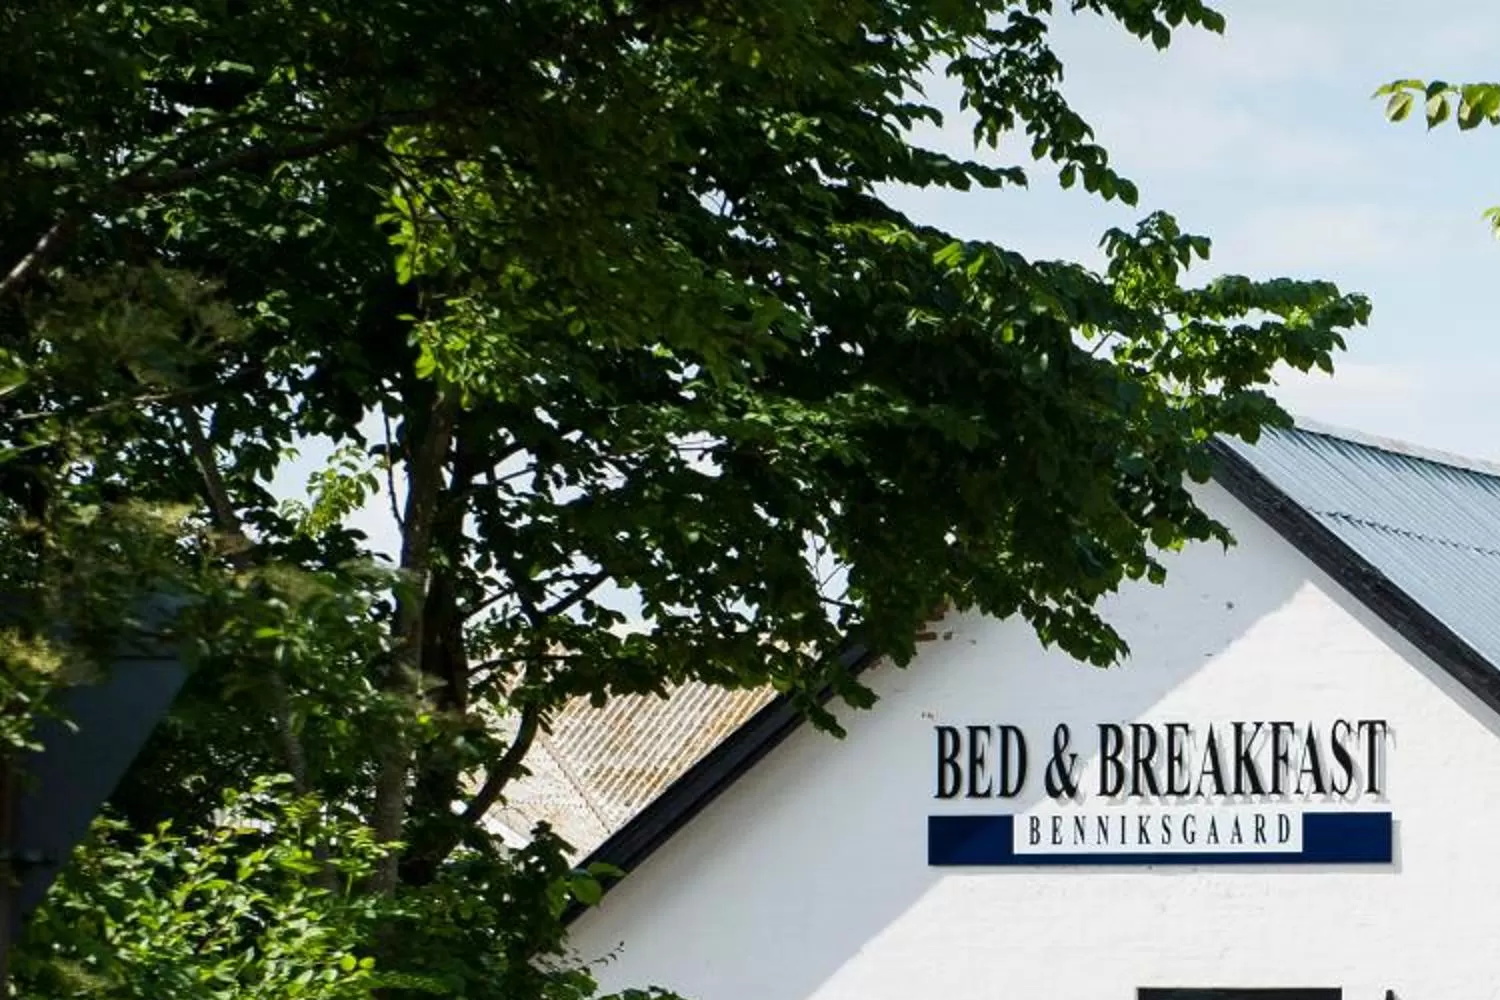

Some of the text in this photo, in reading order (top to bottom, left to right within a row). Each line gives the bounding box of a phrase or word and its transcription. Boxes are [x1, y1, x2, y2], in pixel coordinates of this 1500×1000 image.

[934, 719, 1387, 799] BED & BREAKFAST
[1029, 812, 1291, 846] BENNIKSGAARD
